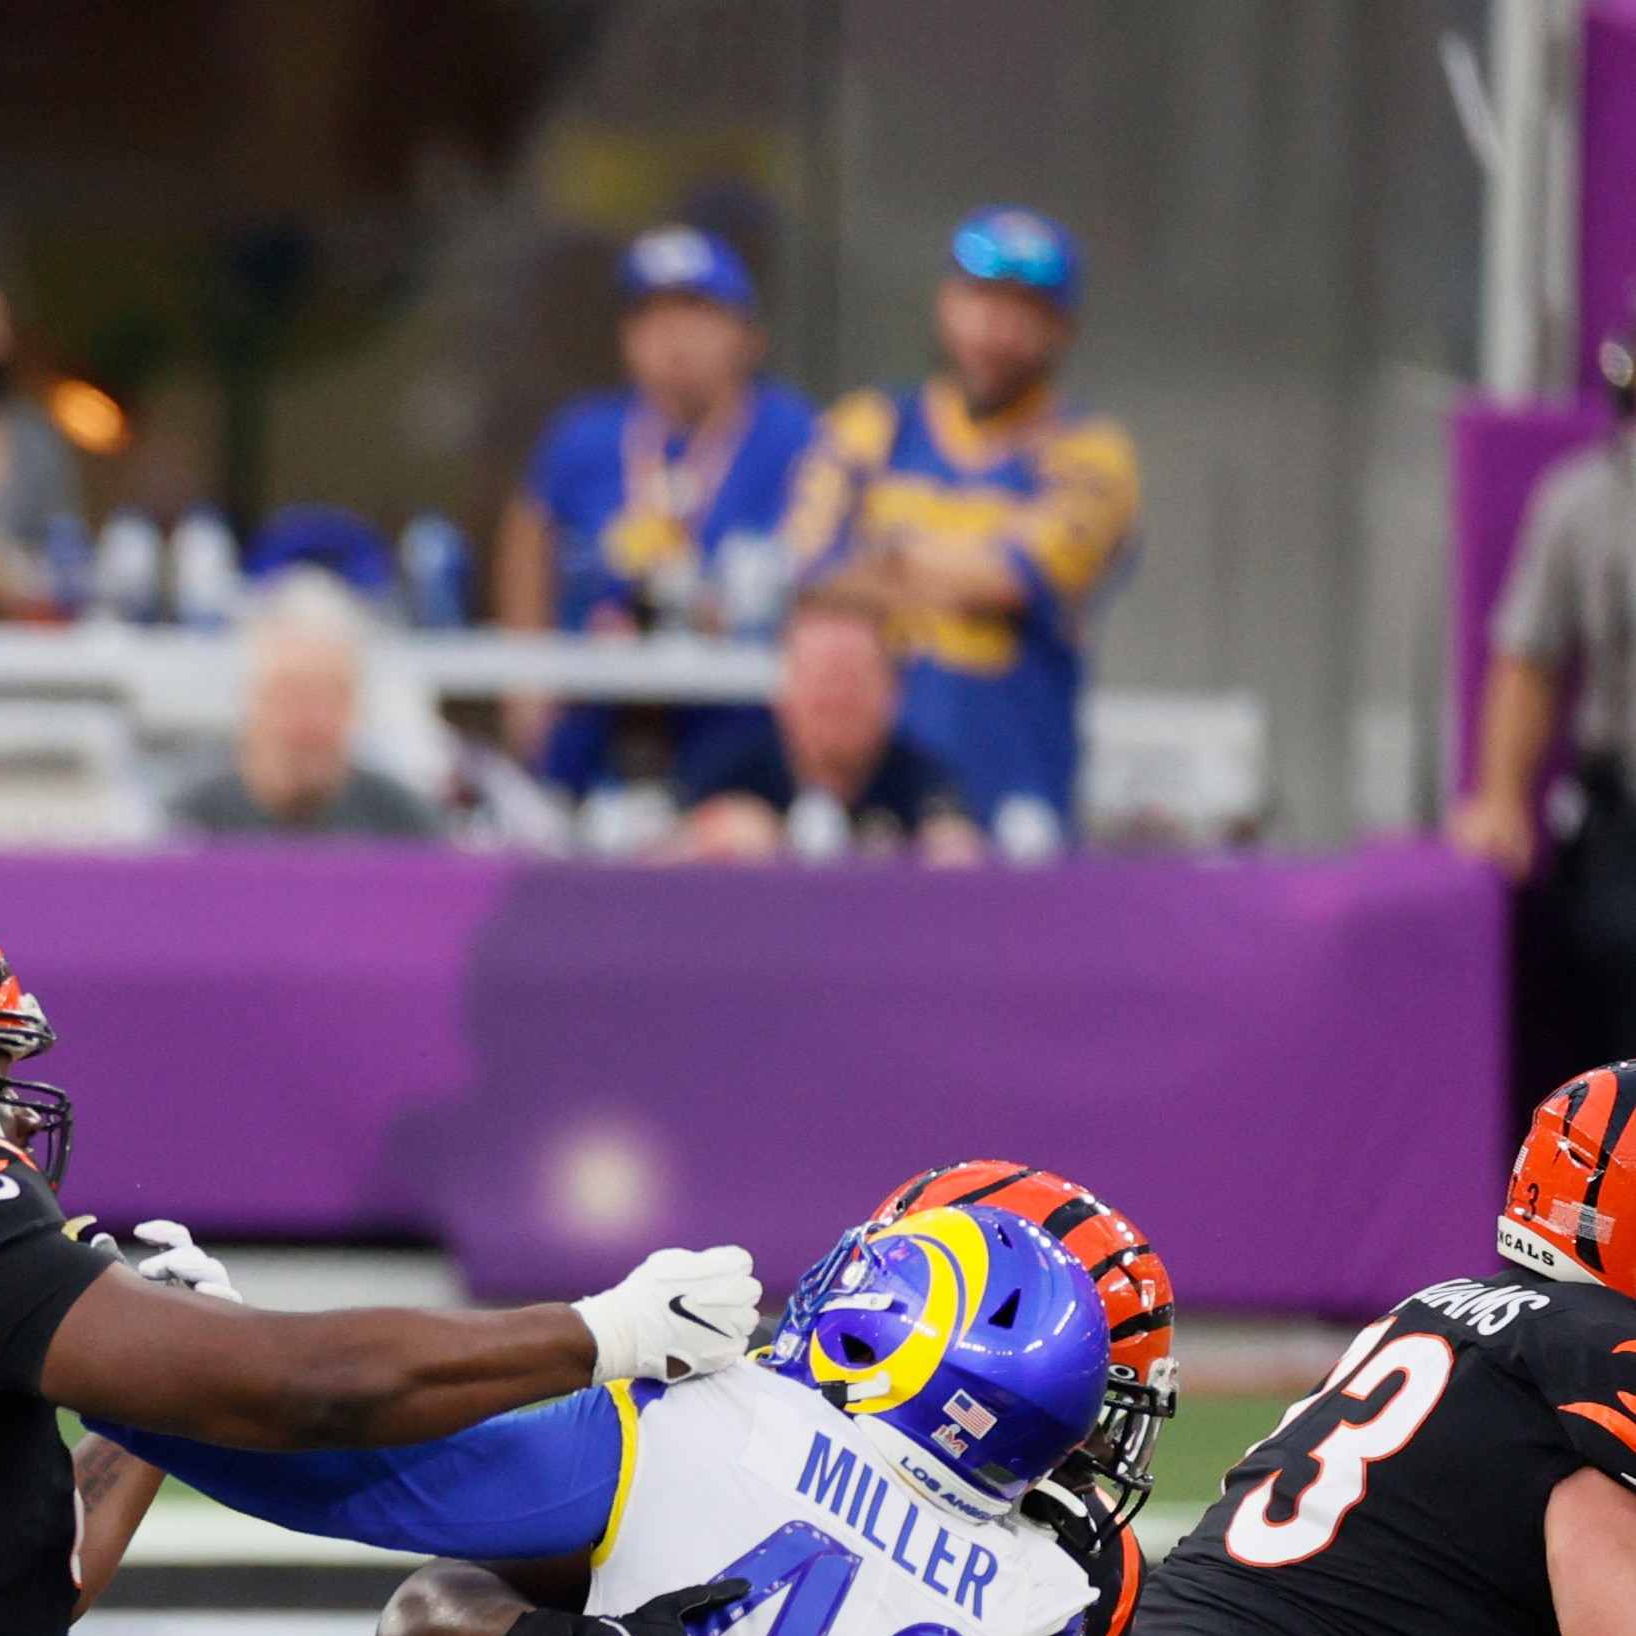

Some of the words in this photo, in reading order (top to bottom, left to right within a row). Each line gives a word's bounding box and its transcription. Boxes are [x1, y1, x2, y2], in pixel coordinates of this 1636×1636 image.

[1498, 1230, 1555, 1267] NGALS
[900, 1456, 943, 1493] LOS
[796, 1430, 999, 1622] MILLER
